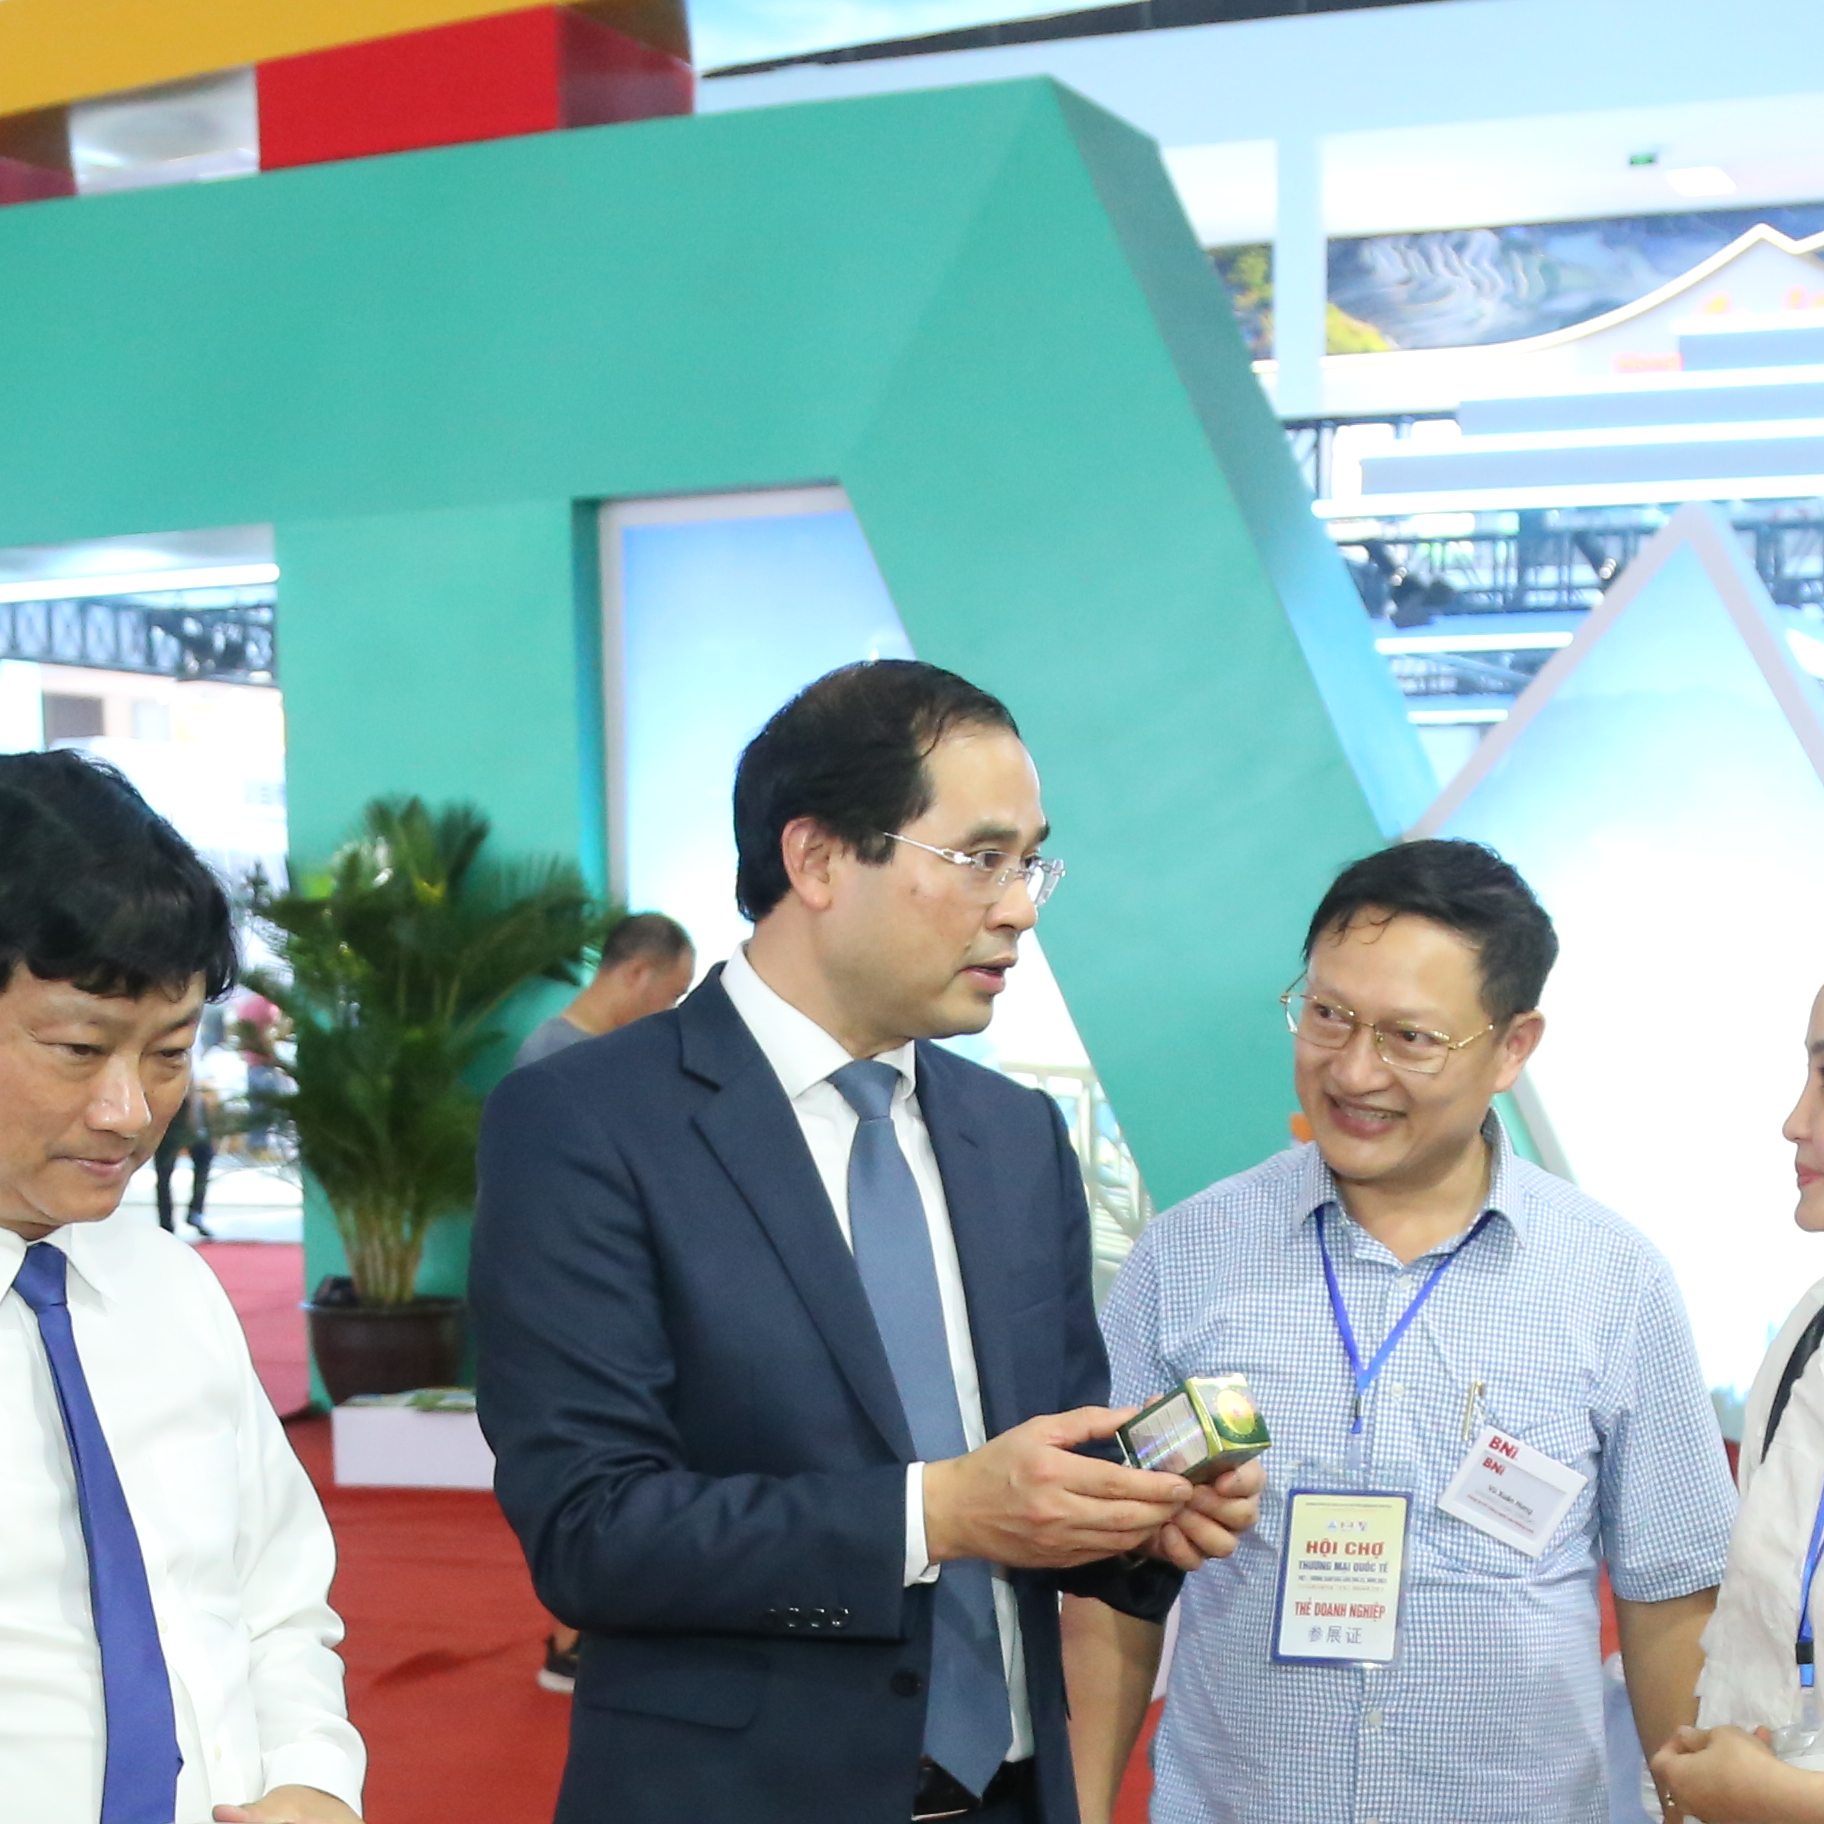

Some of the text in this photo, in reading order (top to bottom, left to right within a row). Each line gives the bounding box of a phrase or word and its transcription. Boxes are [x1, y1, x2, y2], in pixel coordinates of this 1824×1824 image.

[1306, 1539, 1385, 1559] HỘI CHỢ
[1314, 1602, 1346, 1617] DOANH
[1349, 1602, 1386, 1622] NGHIỆP
[1309, 1625, 1363, 1645] 参展证
